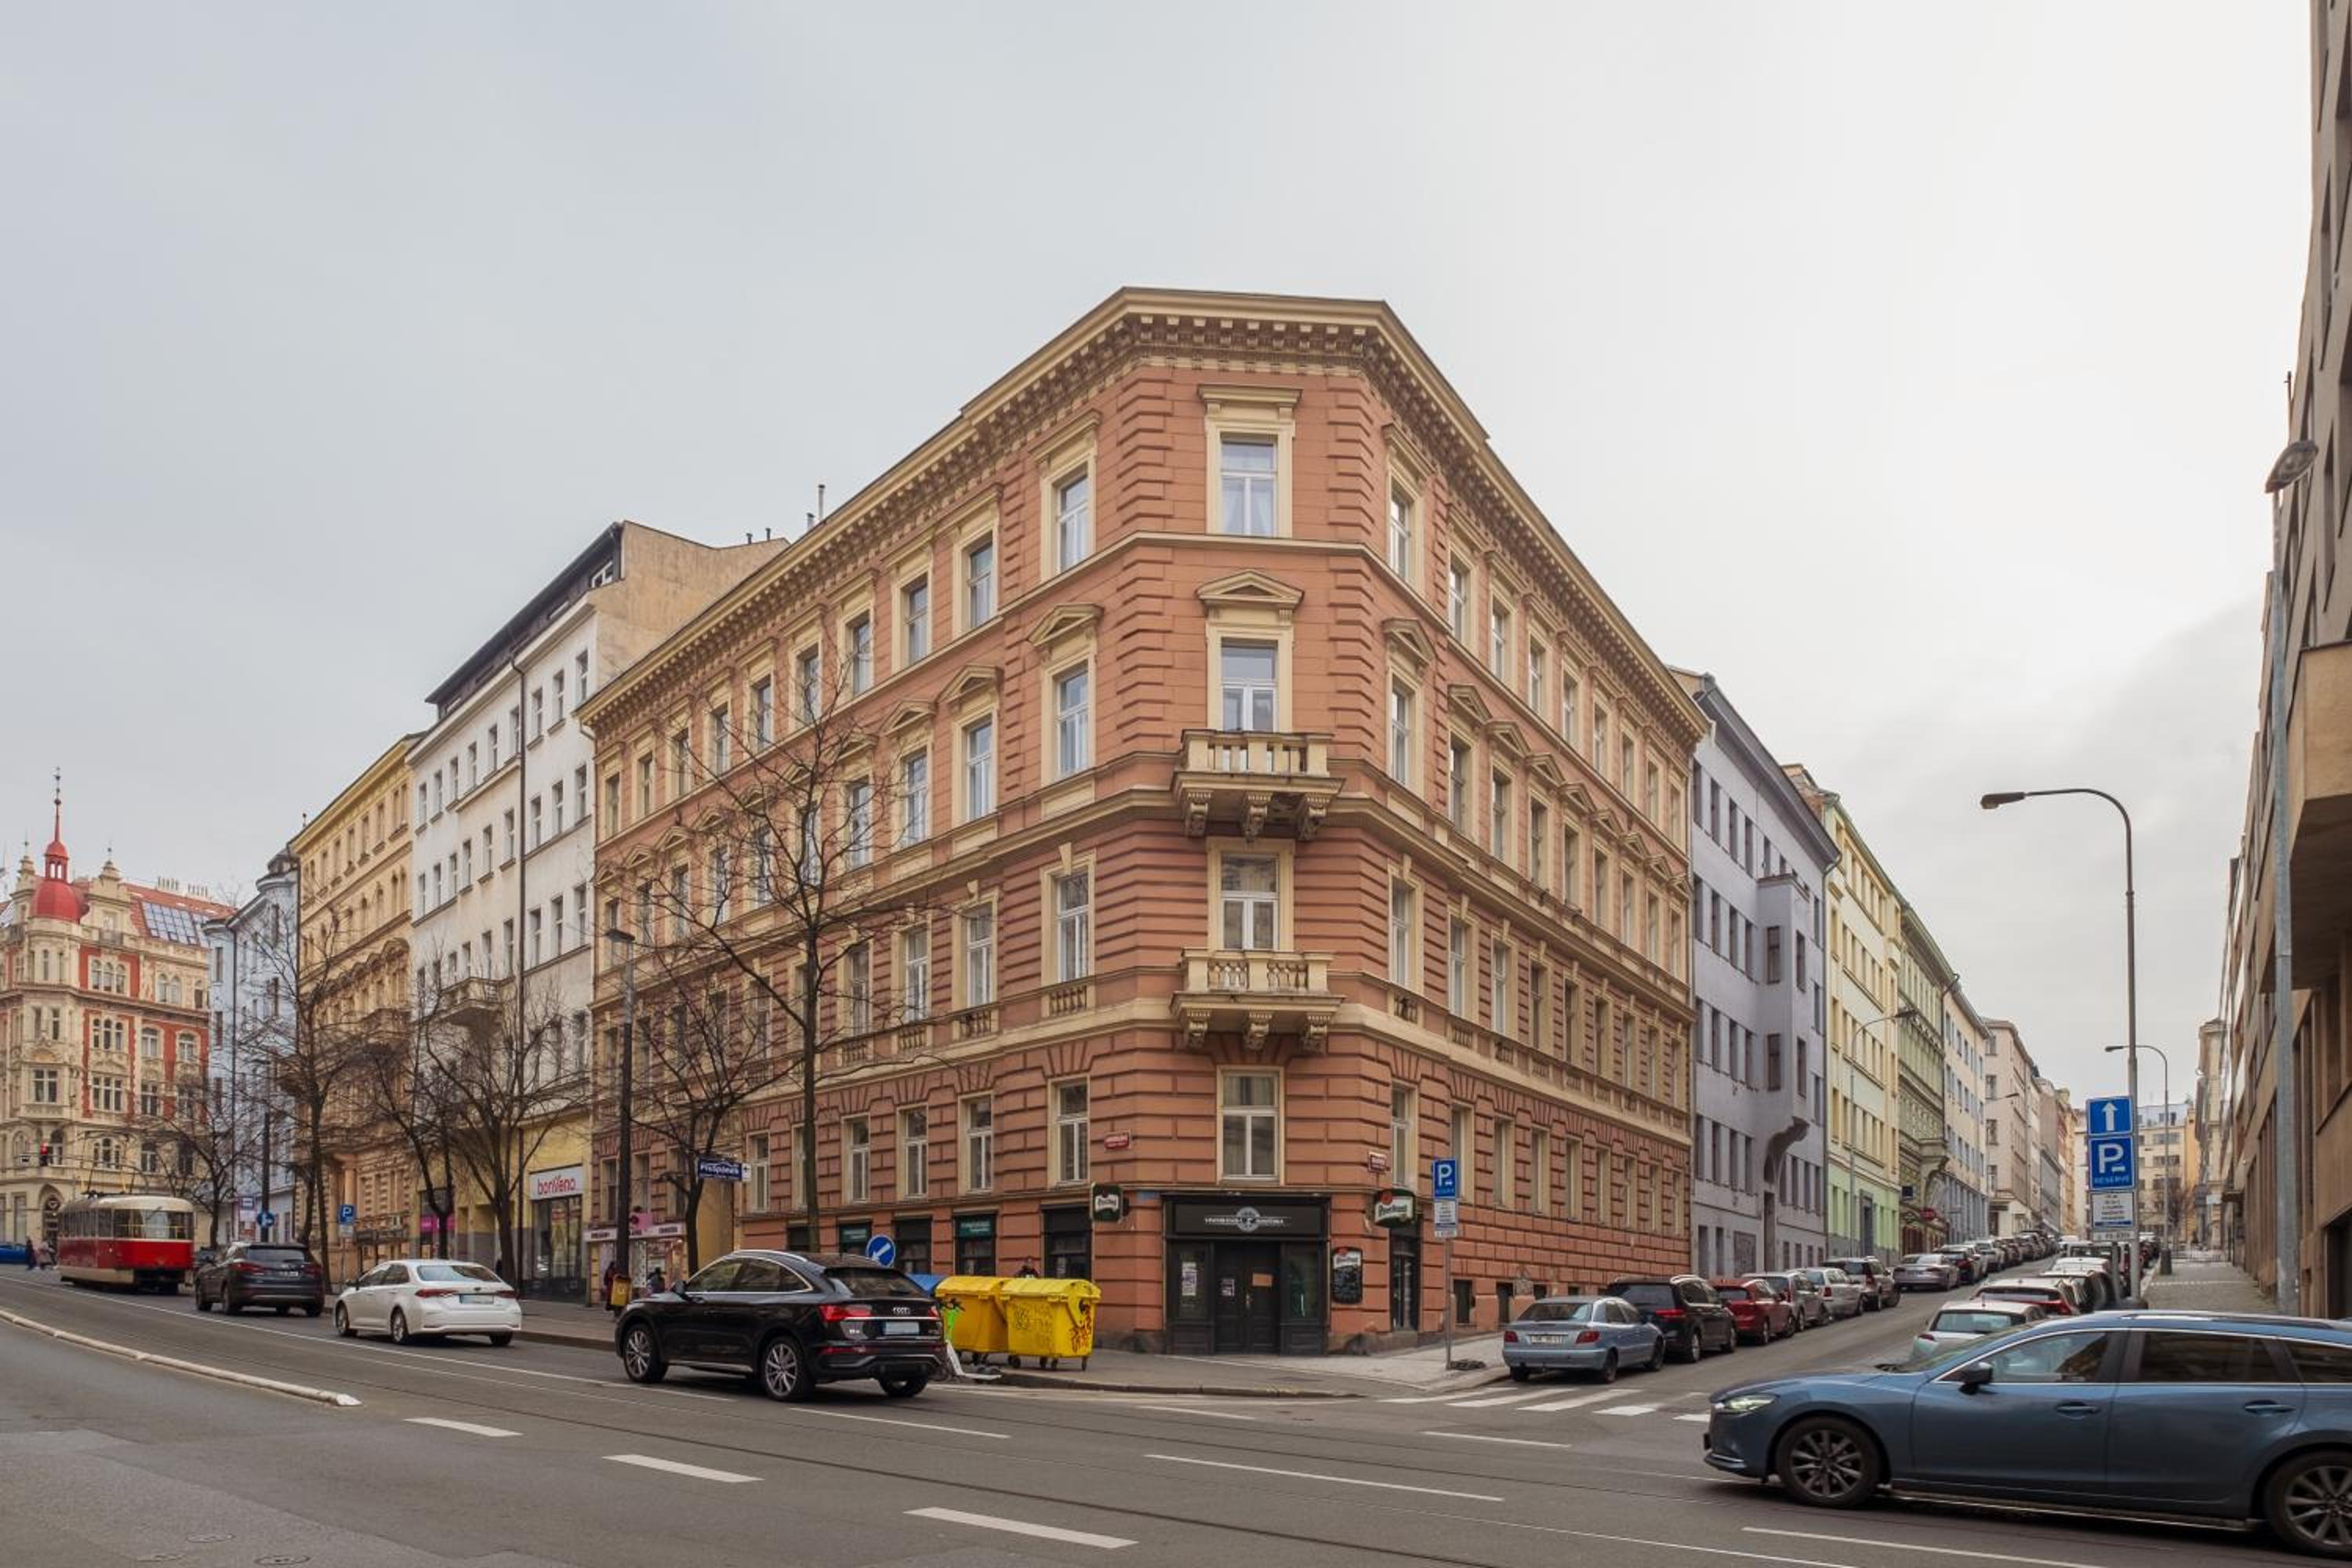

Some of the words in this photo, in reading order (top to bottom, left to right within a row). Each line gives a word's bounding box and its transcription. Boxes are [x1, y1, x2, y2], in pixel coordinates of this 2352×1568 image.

[2098, 1143, 2124, 1174] P
[1438, 1164, 1453, 1186] P
[343, 1207, 352, 1217] P
